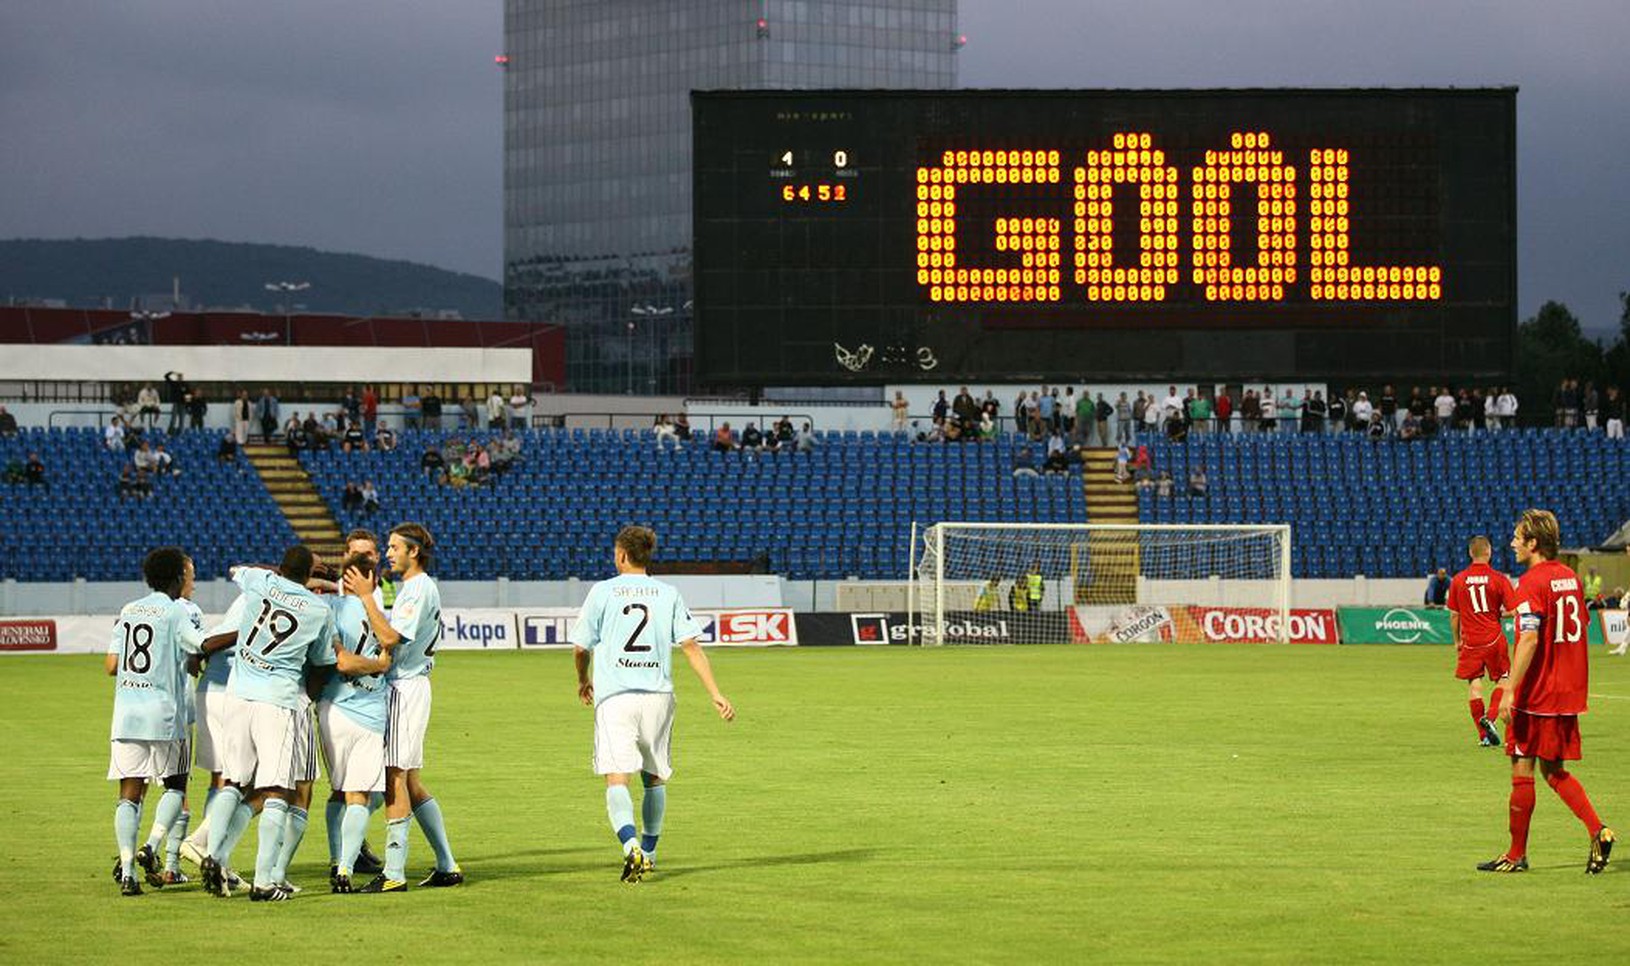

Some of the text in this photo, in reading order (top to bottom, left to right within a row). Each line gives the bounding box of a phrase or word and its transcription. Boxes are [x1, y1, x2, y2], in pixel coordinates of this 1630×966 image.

[834, 150, 847, 168] 0
[1467, 585, 1489, 614] 11
[1554, 595, 1582, 643] 13
[123, 622, 154, 674] 18
[246, 599, 299, 656] 19
[622, 603, 652, 653] 2
[1375, 620, 1430, 630] PHOENIX
